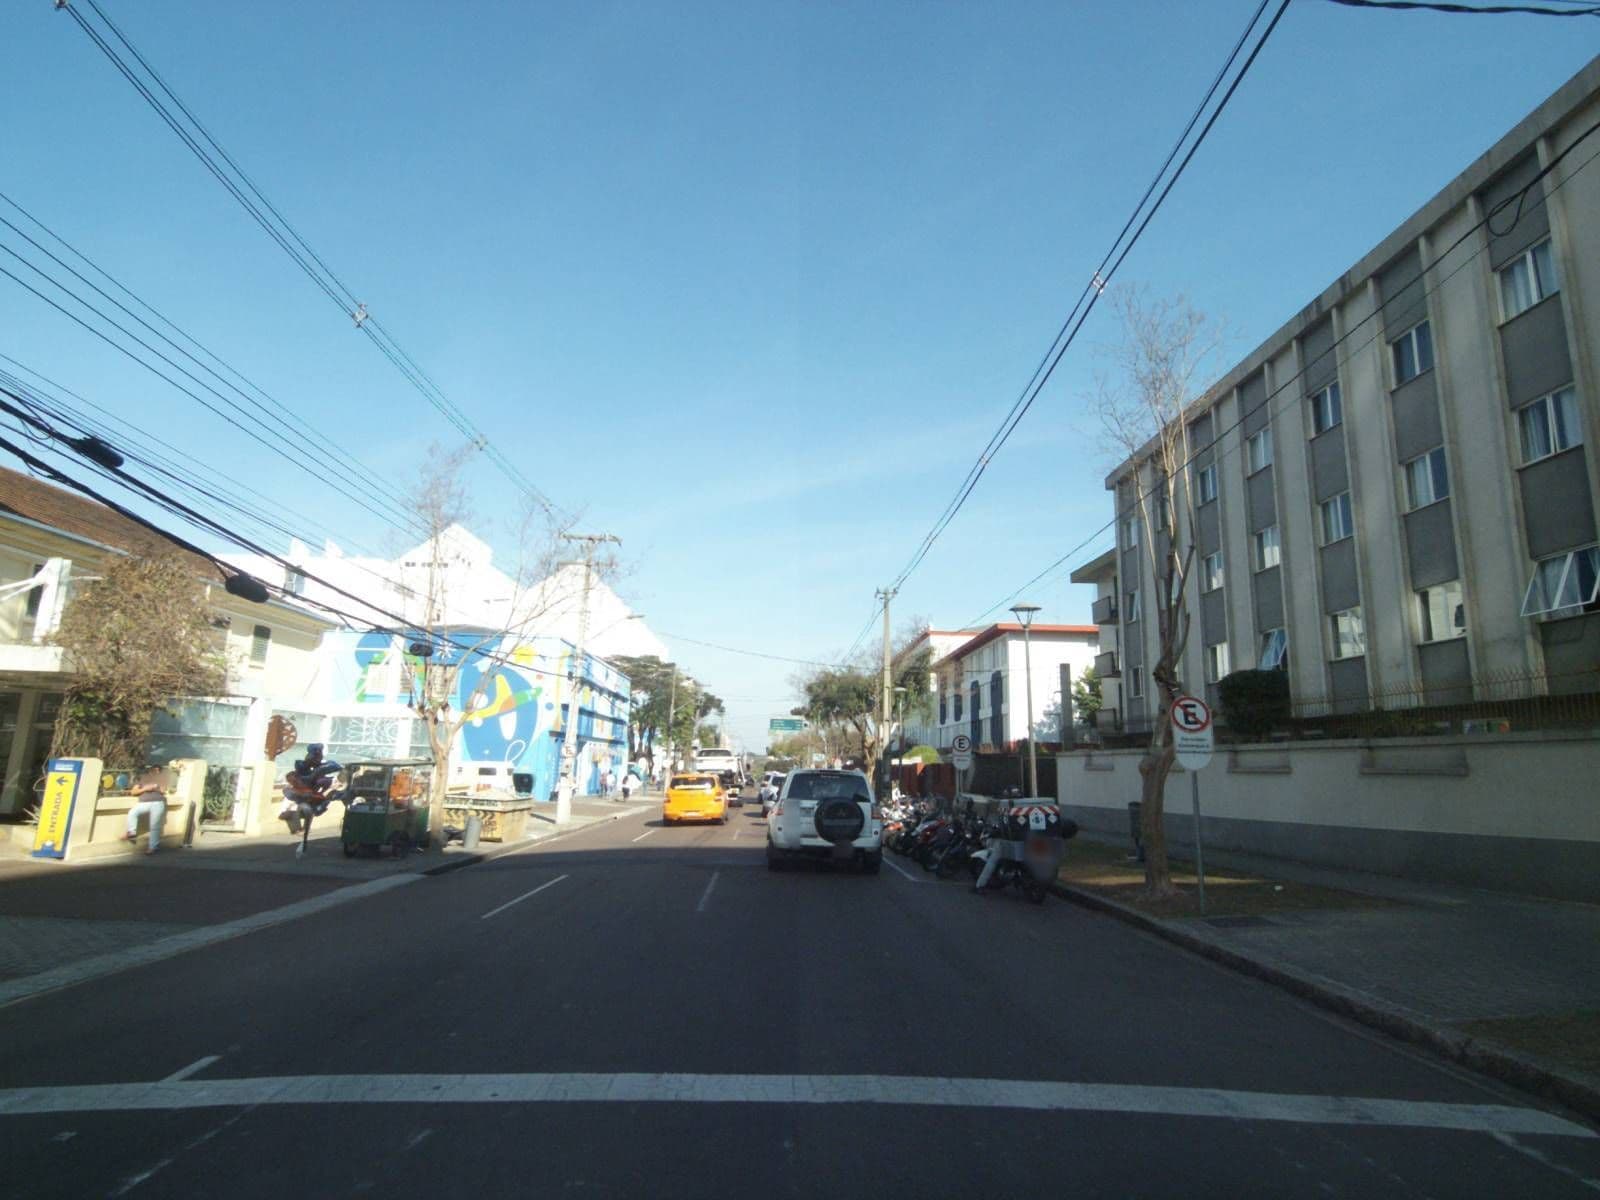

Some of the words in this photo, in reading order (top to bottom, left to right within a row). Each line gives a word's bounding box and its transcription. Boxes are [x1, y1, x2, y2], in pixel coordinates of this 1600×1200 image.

[1183, 703, 1198, 725] E
[958, 738, 966, 749] E
[48, 791, 63, 833] ENTRADA
